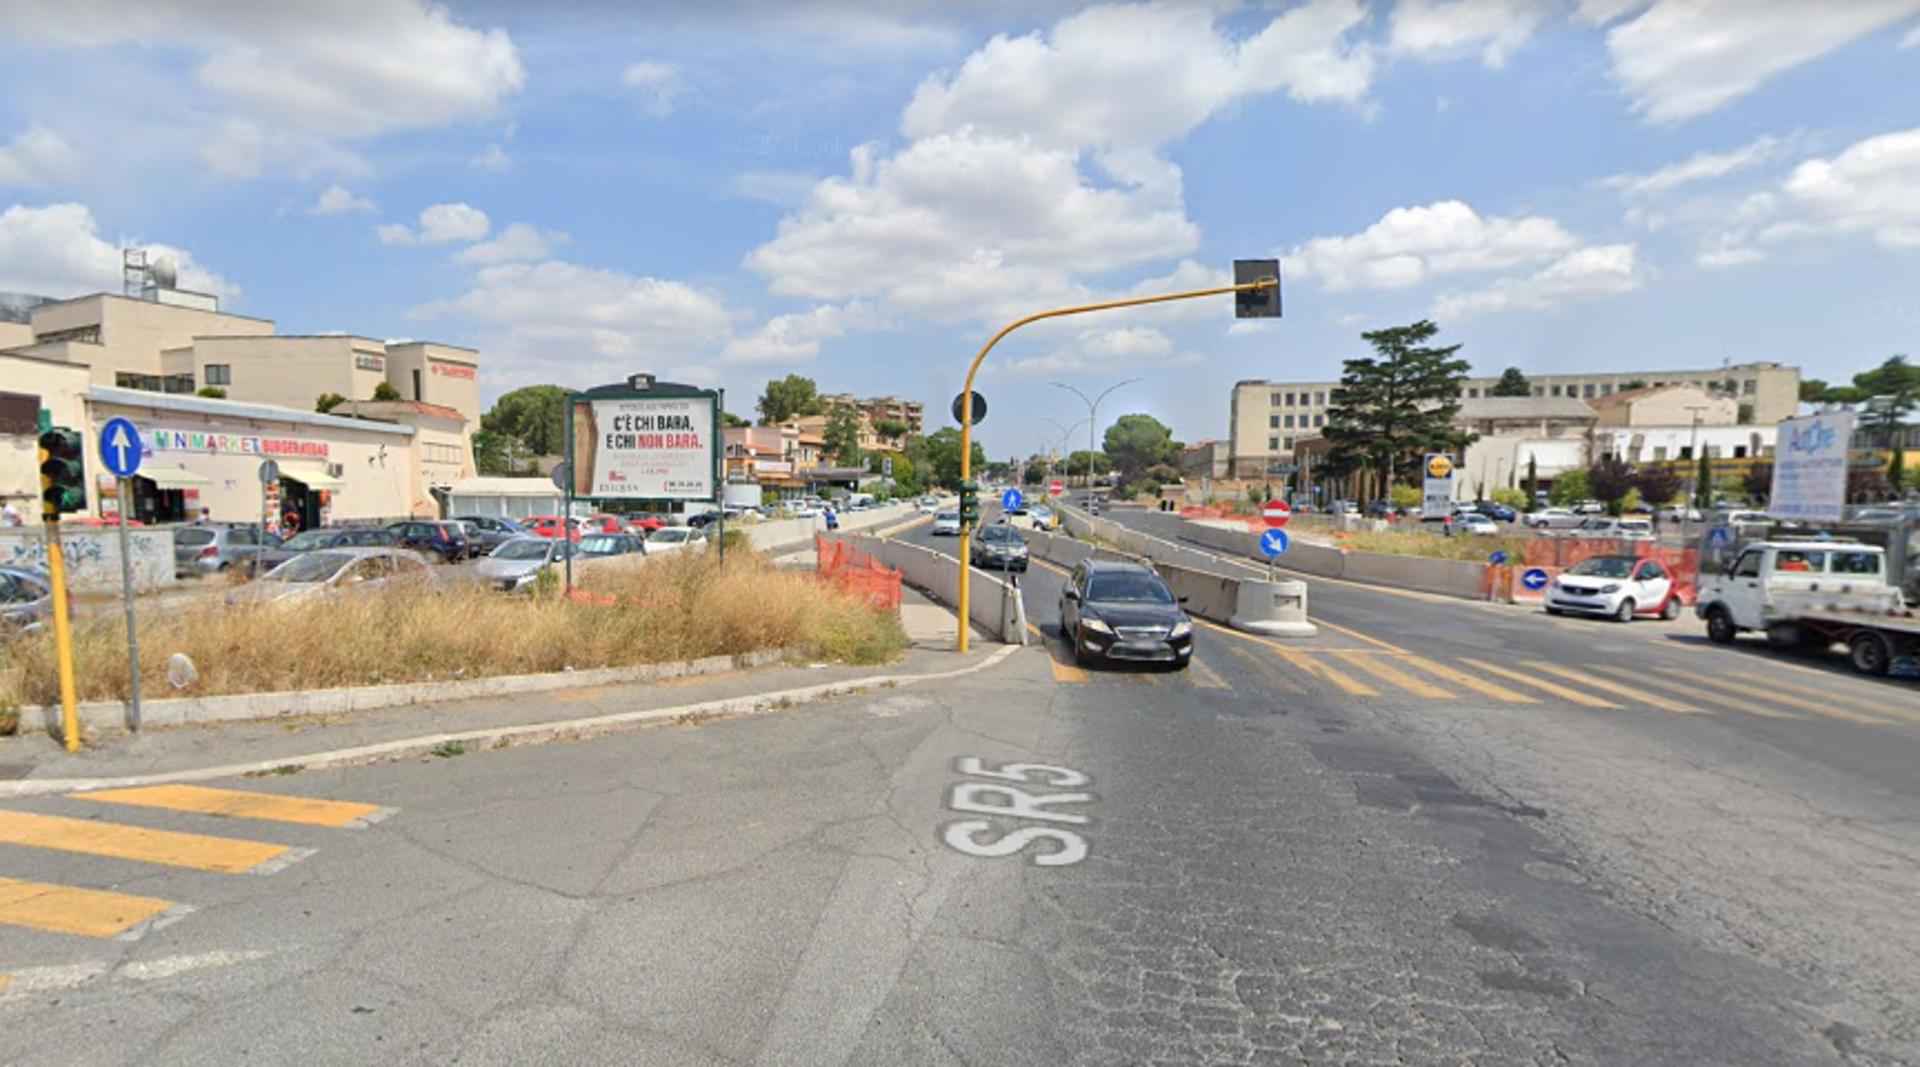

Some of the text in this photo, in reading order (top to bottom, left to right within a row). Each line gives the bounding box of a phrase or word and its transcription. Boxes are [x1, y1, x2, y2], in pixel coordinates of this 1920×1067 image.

[614, 413, 694, 431] C'È CHI BARA,
[606, 433, 703, 449] E CHI NON BARA.
